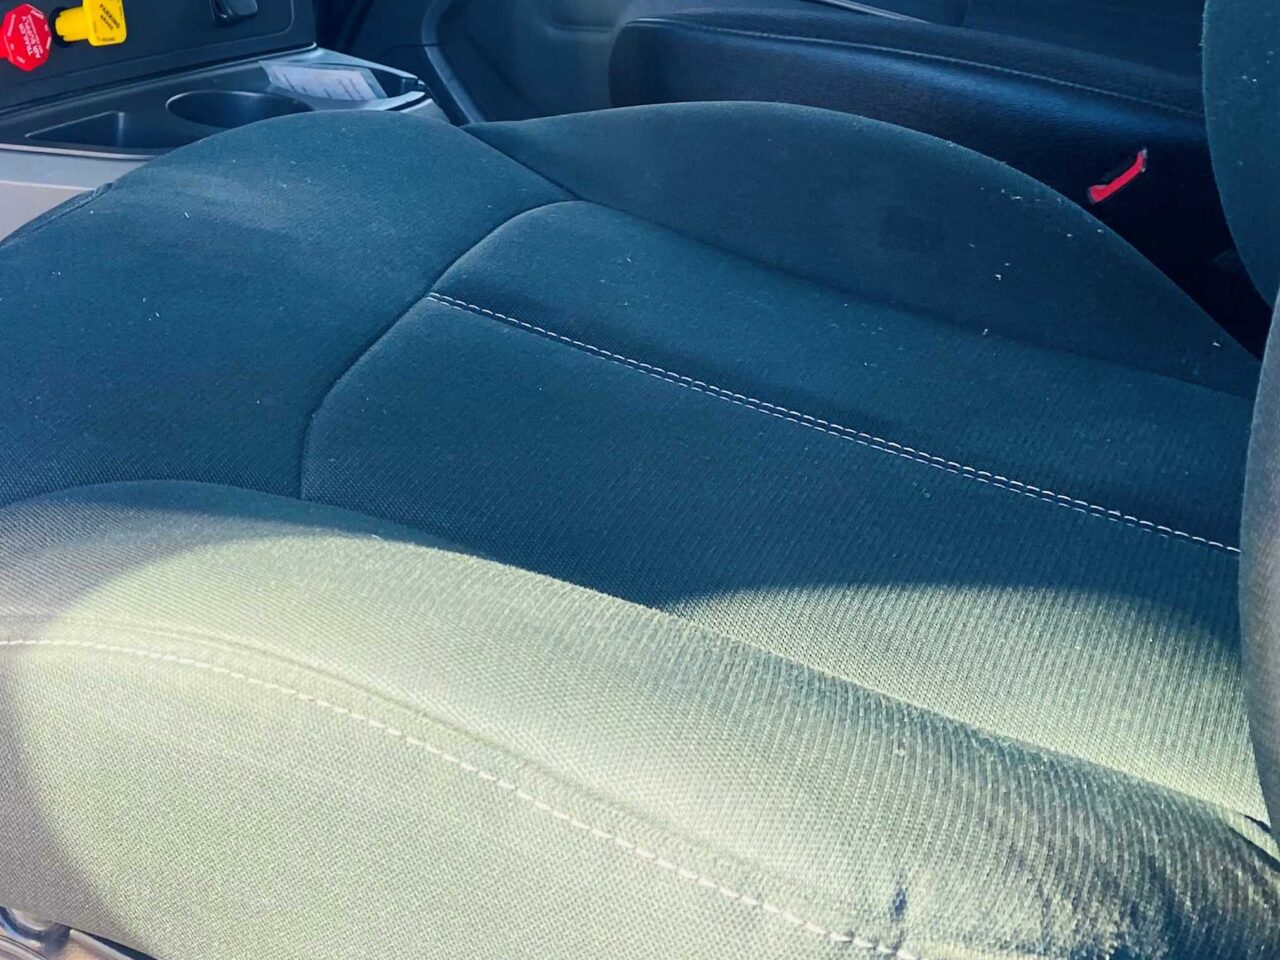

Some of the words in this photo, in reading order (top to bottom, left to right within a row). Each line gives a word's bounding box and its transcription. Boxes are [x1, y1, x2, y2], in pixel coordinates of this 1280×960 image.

[22, 15, 37, 45] SUPPLY
[99, 3, 121, 29] PARKING
[18, 23, 33, 56] TRAILER
